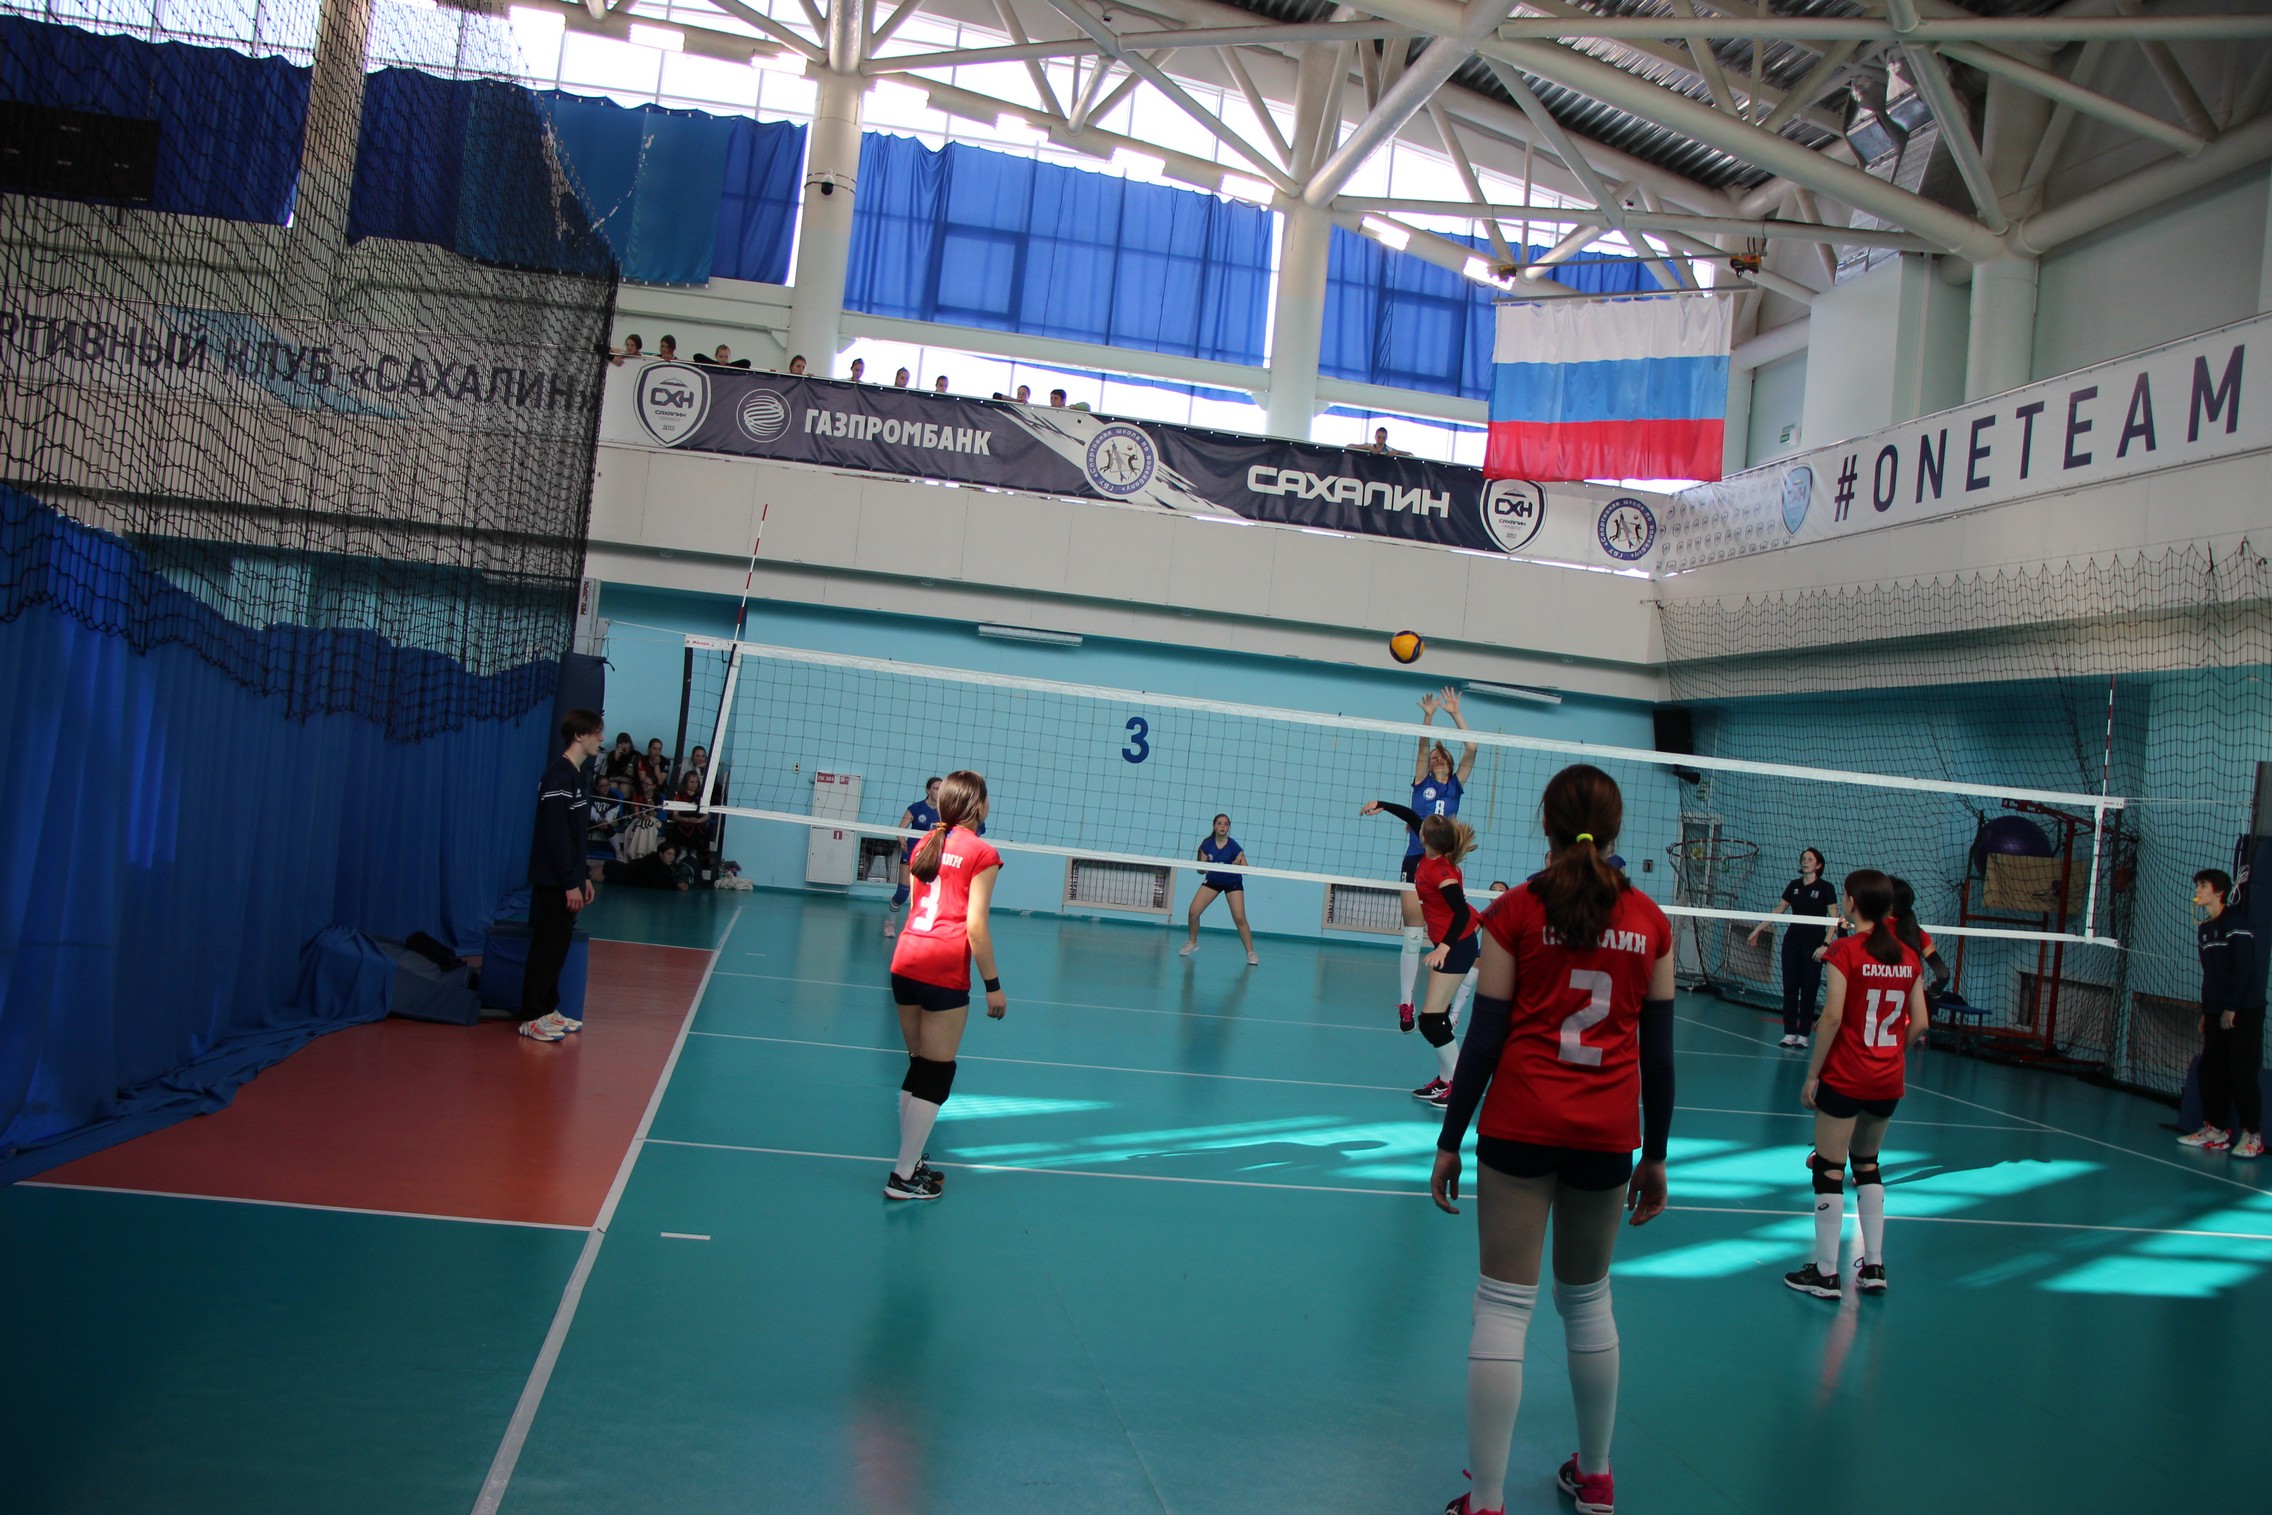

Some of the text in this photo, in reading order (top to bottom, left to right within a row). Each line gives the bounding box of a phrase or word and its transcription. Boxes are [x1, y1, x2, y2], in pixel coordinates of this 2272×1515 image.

[225, 336, 333, 388] КЛУБ
[804, 408, 992, 456] ГАЗПРОМБАНК
[1834, 344, 2245, 522] #ONETEAM
[1247, 465, 1450, 518] САХАЛИН
[1122, 717, 1149, 763] 3
[1434, 800, 1445, 816] 8
[911, 873, 941, 932] 3
[1862, 964, 1912, 978] САХАЛИН
[1558, 969, 1612, 1067] 2
[1864, 989, 1905, 1047] 12
